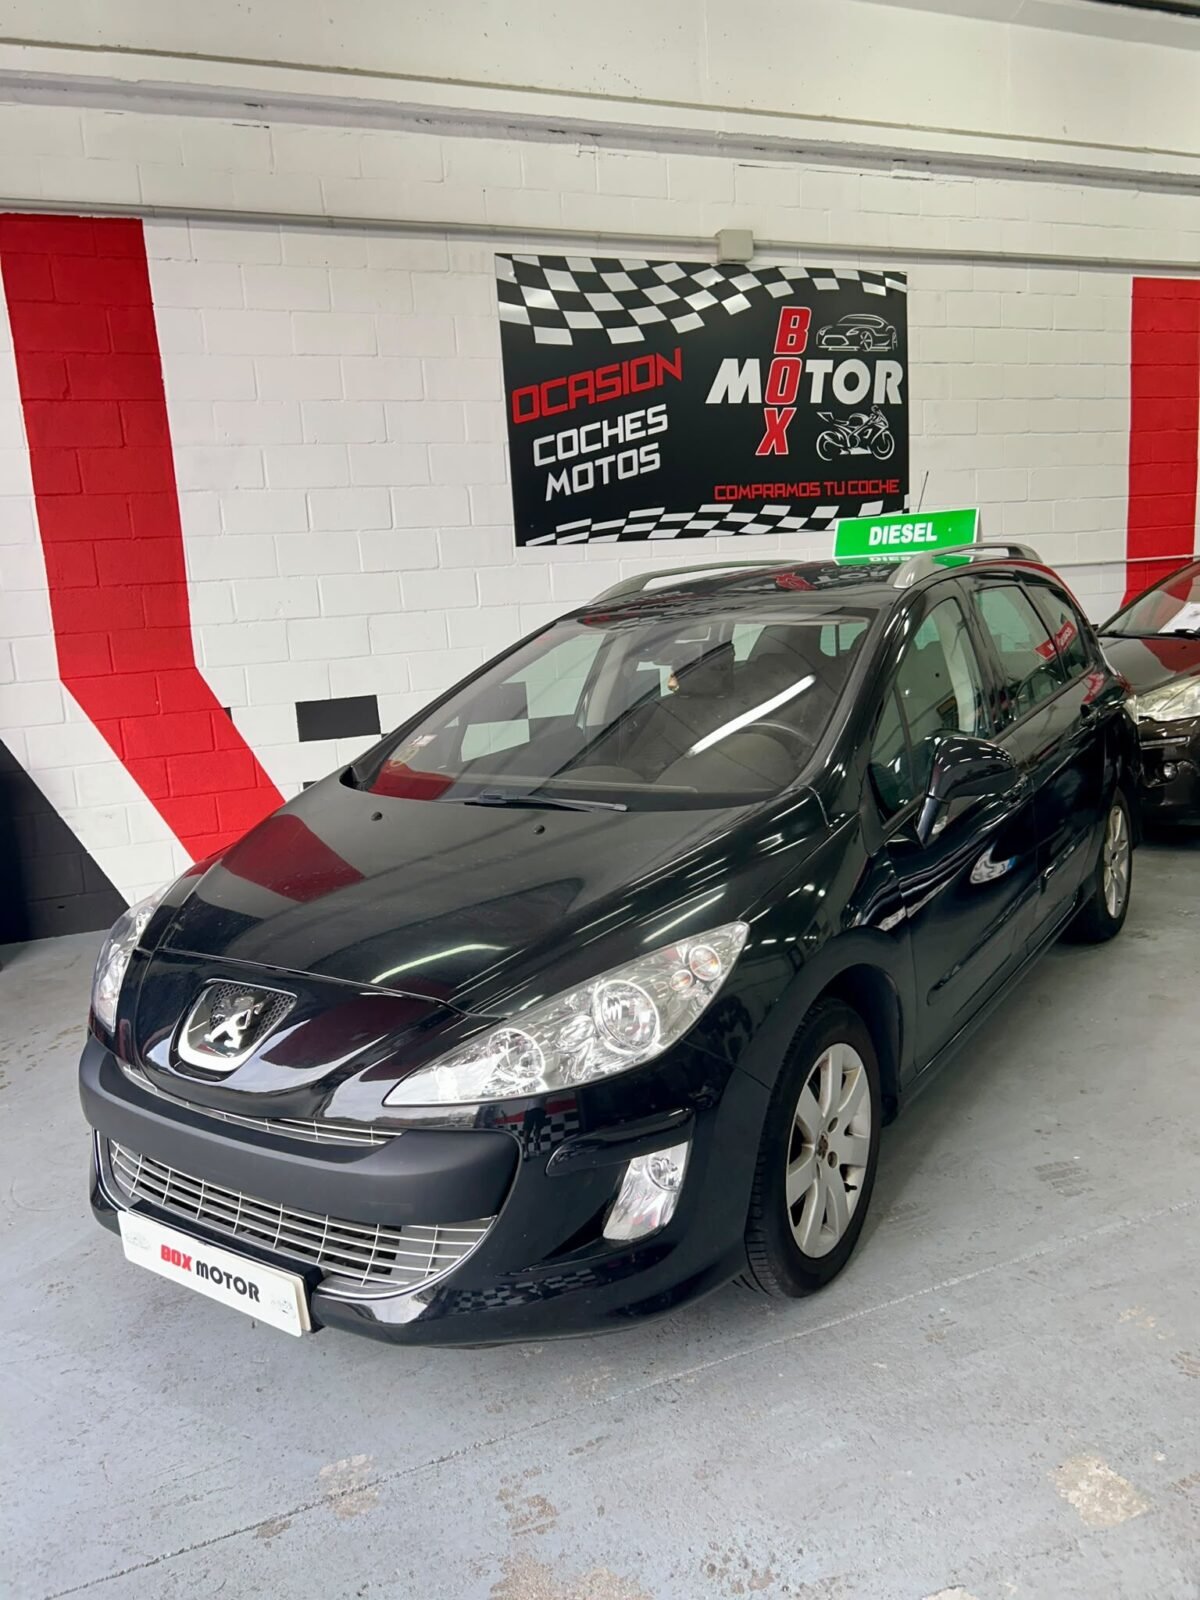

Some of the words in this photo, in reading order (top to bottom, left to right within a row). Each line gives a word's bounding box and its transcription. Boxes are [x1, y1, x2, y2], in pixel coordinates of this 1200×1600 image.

[511, 347, 683, 424] OCASION
[704, 357, 904, 405] MOTOR
[754, 305, 812, 456] BOX
[533, 403, 669, 467] COCHES
[545, 441, 661, 502] MOTOS
[713, 481, 821, 501] COMPRAMOS
[823, 480, 845, 496] TU
[847, 479, 900, 495] COCHE
[868, 522, 938, 546] DIESEL
[160, 1244, 192, 1271] BOX
[195, 1259, 261, 1303] MOTOR
